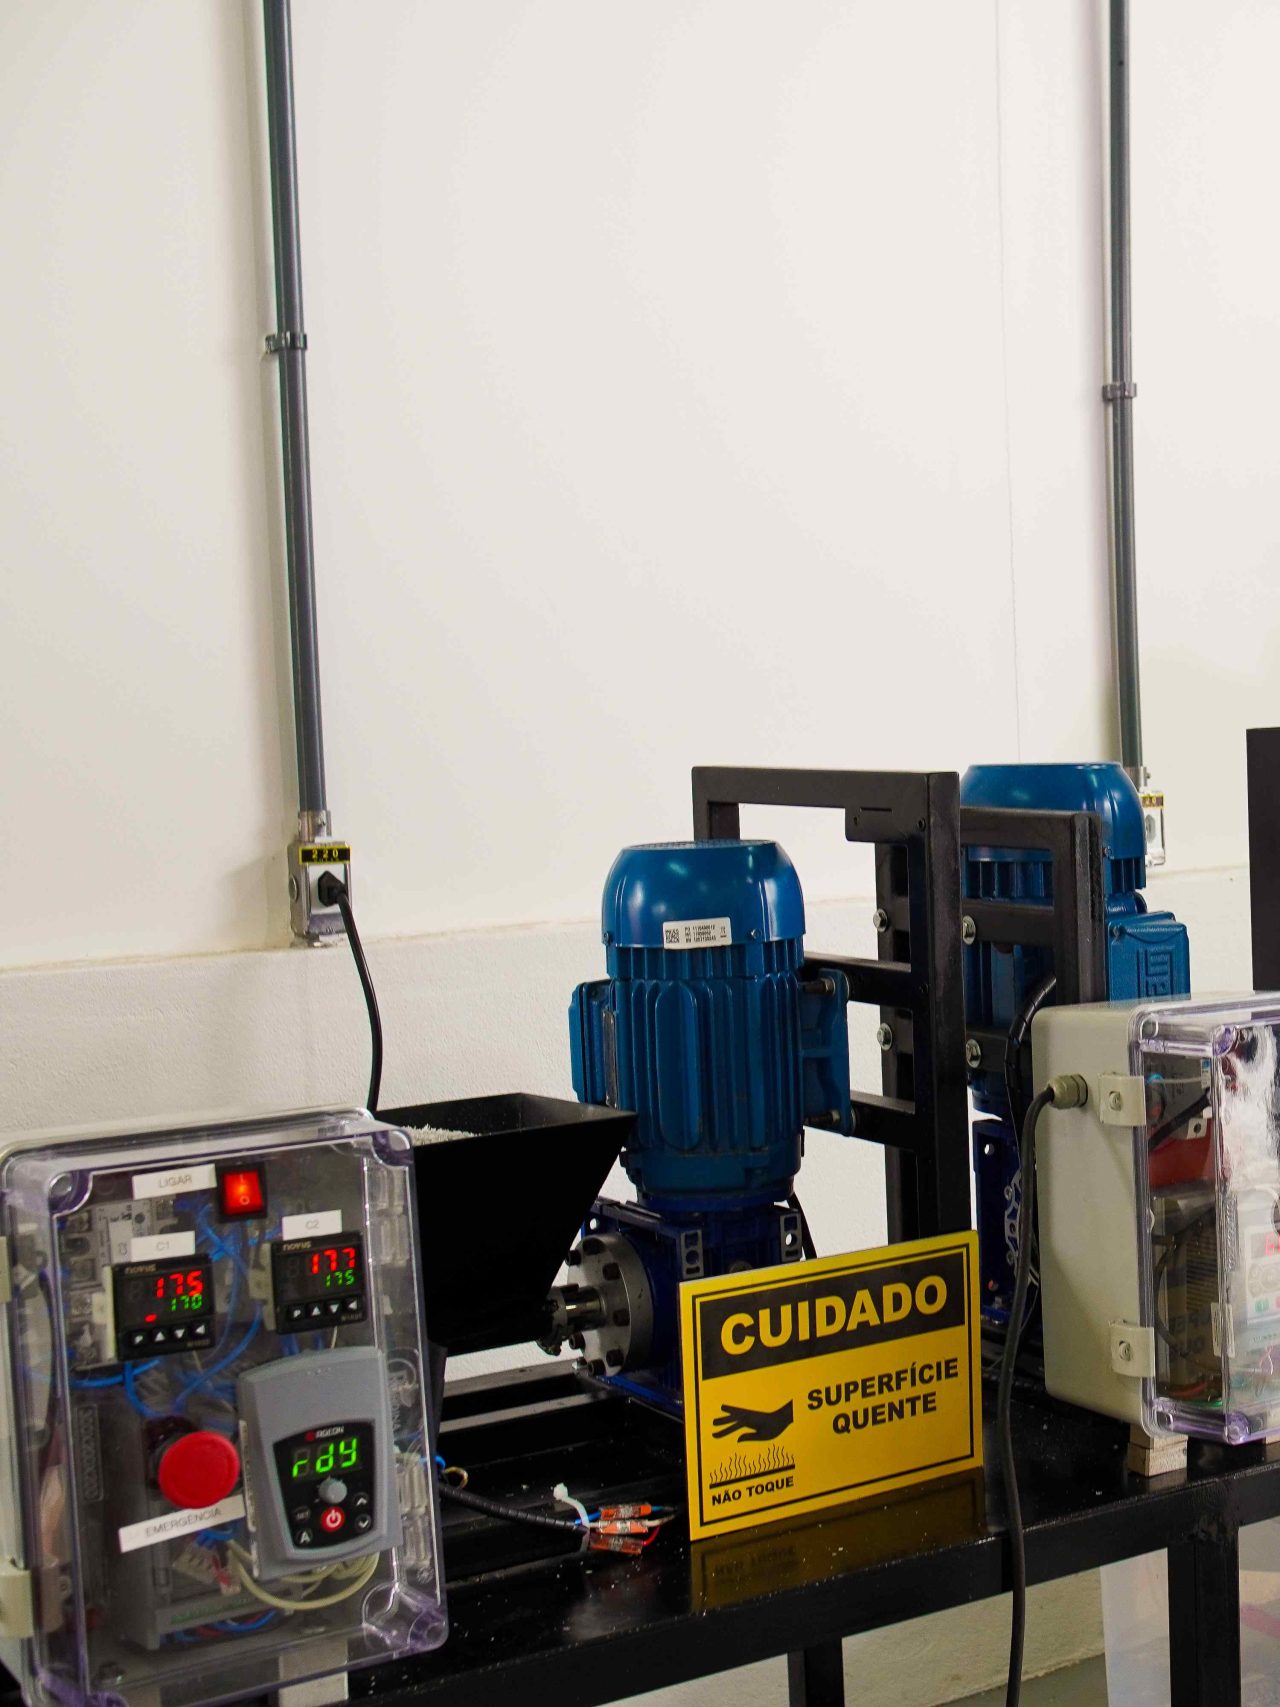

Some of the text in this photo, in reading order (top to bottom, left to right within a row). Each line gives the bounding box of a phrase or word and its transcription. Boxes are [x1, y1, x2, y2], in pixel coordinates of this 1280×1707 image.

[159, 1174, 193, 1189] LIGAR
[305, 1219, 320, 1230] C2
[156, 1241, 171, 1251] C1
[311, 1247, 356, 1275] 177
[156, 1270, 204, 1298] 175
[326, 1269, 355, 1287] 175
[171, 1295, 203, 1312] 170
[720, 1275, 948, 1356] CUIDADO
[807, 1357, 959, 1411] SUPERFÍCIE
[832, 1391, 937, 1434] QUENTE
[711, 1475, 795, 1507] NÃO TOQUE
